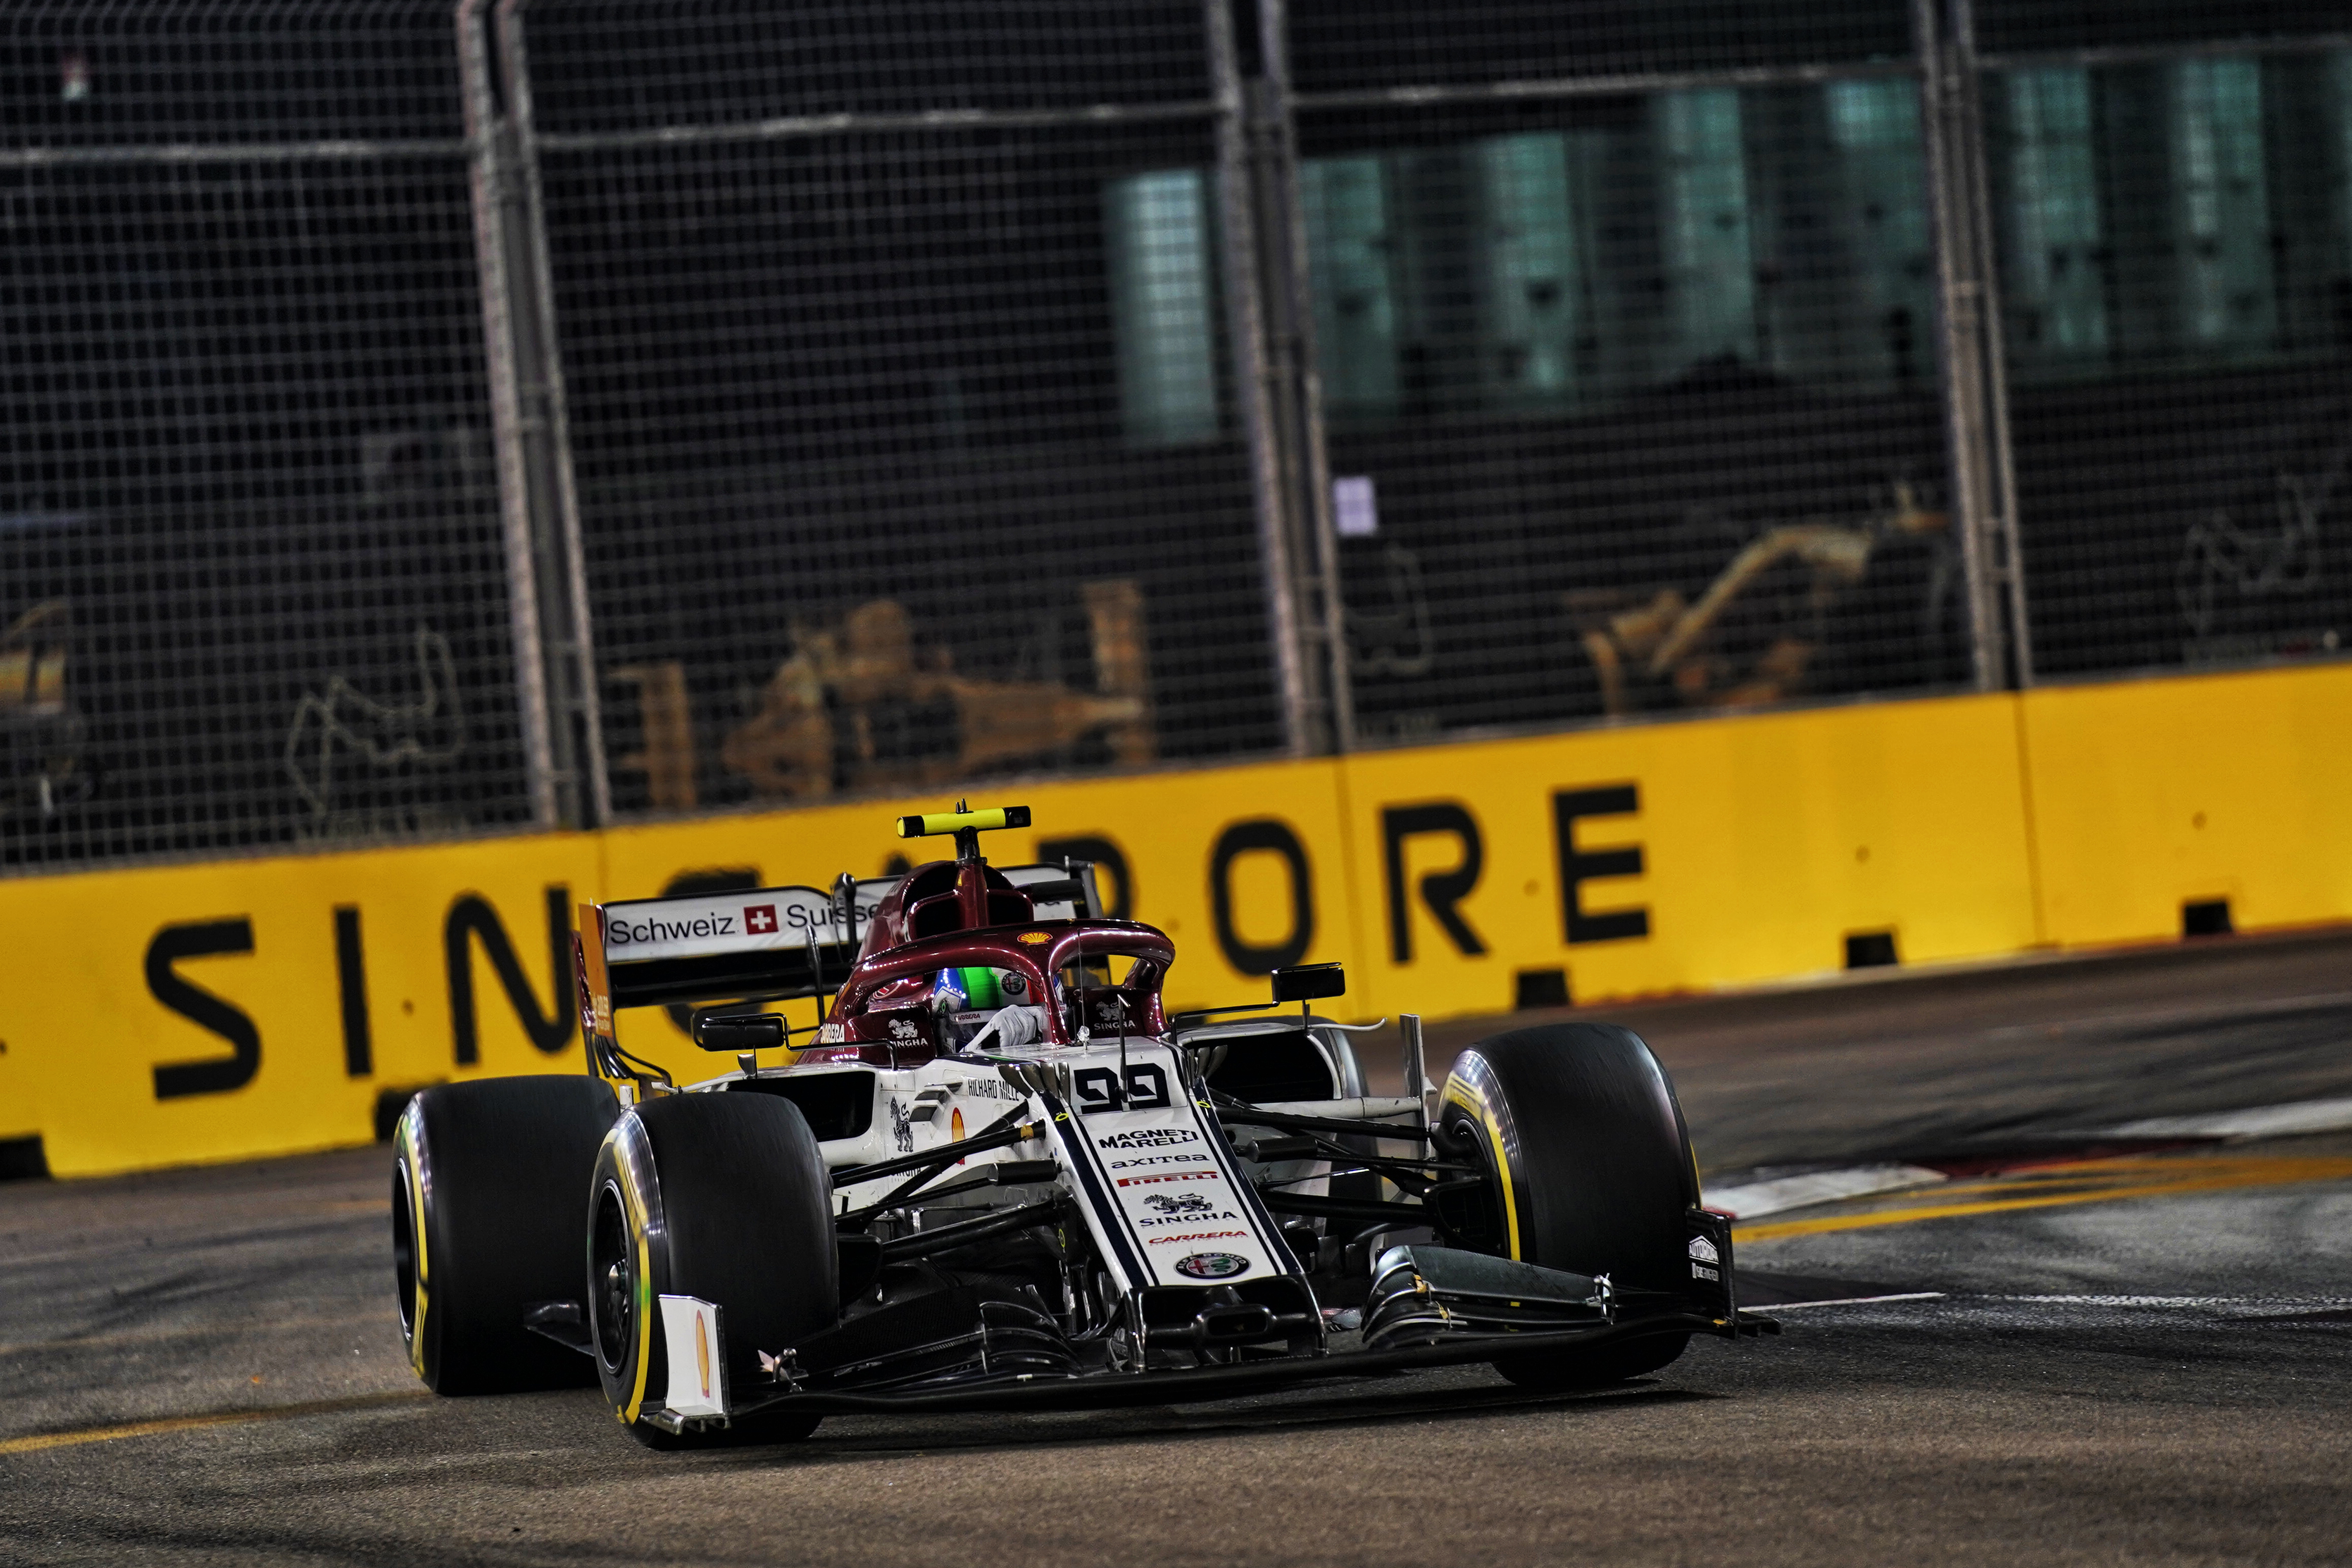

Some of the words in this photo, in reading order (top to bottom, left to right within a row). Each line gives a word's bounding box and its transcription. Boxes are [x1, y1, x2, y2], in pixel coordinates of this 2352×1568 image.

[610, 912, 735, 944] Schweiz
[144, 780, 1651, 1100] SINPORE
[893, 1038, 928, 1047] INGHA
[968, 1078, 997, 1098] RICHARD
[999, 1080, 1019, 1101] MILLE
[1073, 1063, 1171, 1114] 99
[1099, 1129, 1199, 1146] MAGNETI
[1099, 1132, 1199, 1148] MARELLI
[1116, 1171, 1218, 1187] PIRELLI
[1139, 1212, 1238, 1227] SINGHA
[1149, 1231, 1247, 1244] CARRERA
